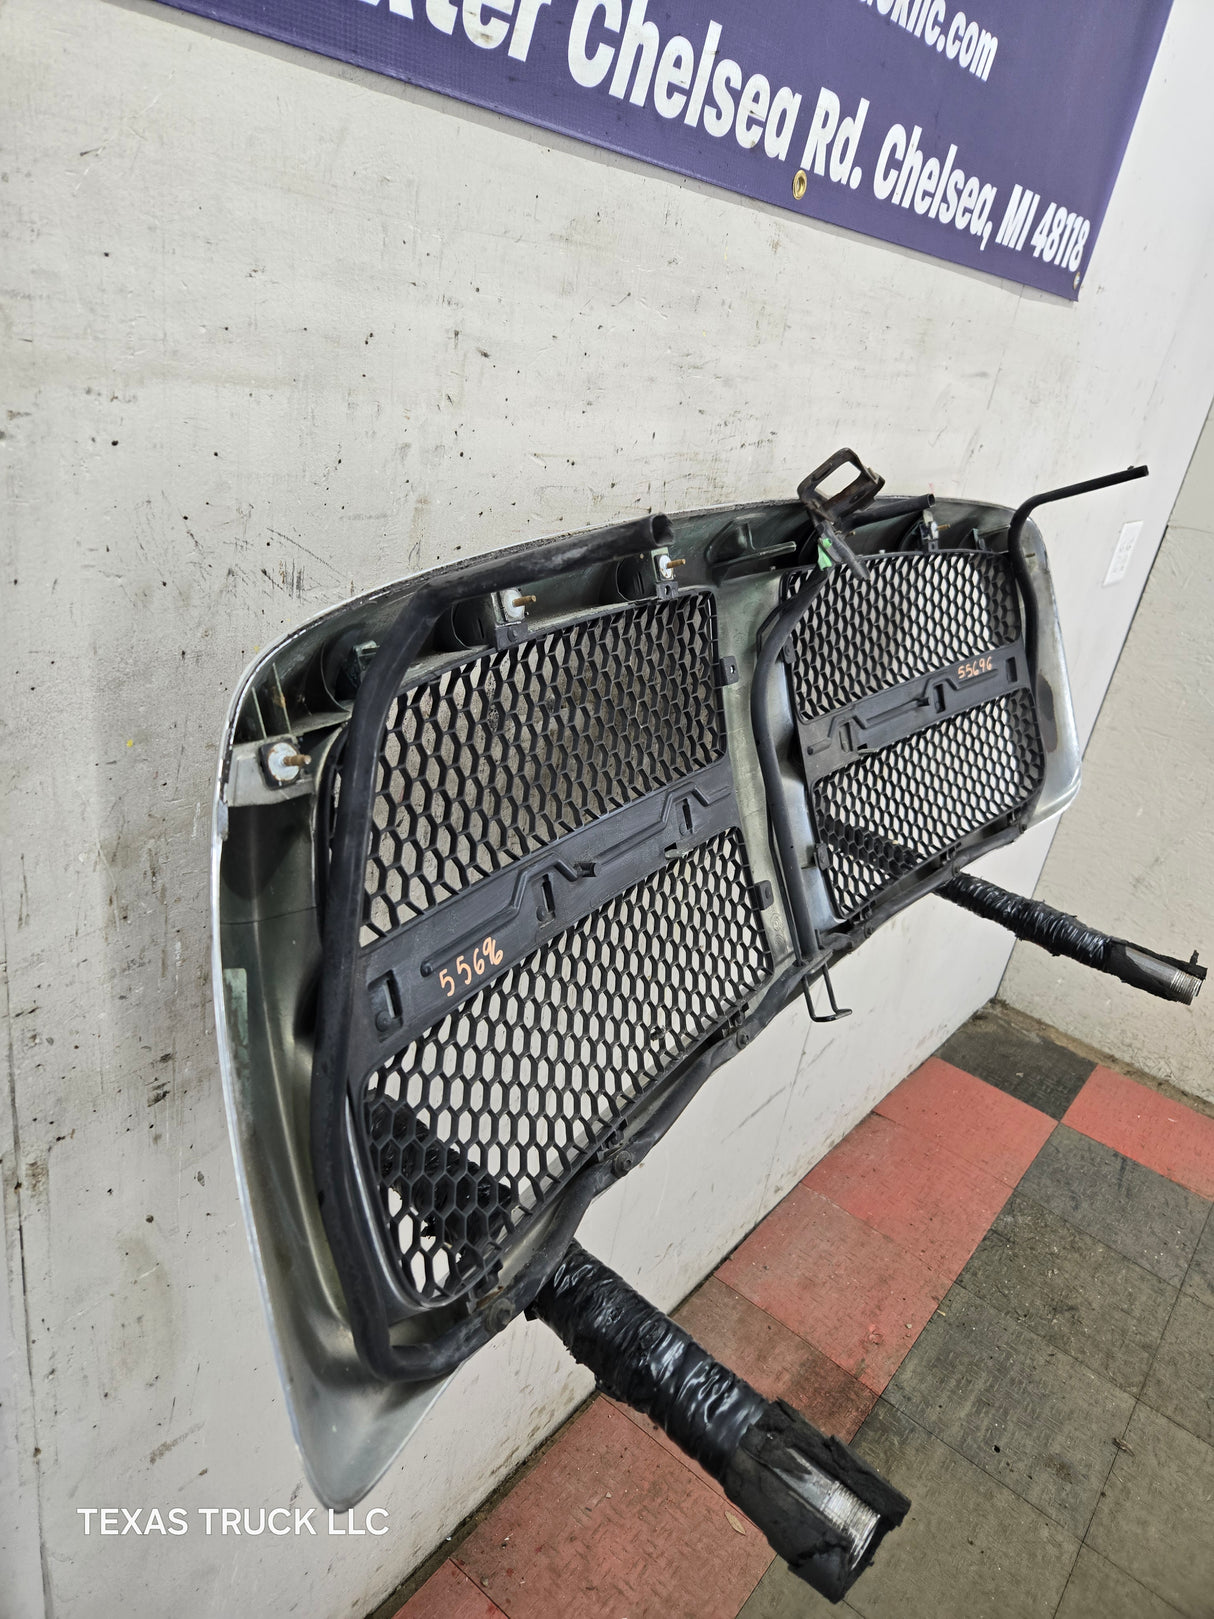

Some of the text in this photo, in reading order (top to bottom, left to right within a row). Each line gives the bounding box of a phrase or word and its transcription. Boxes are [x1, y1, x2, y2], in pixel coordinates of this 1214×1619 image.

[860, 0, 999, 82] llc.com
[357, 0, 1091, 273] er Chelsea Rd. Chelsea, MI 48118
[957, 655, 993, 680] 55696
[438, 936, 504, 998] 55696
